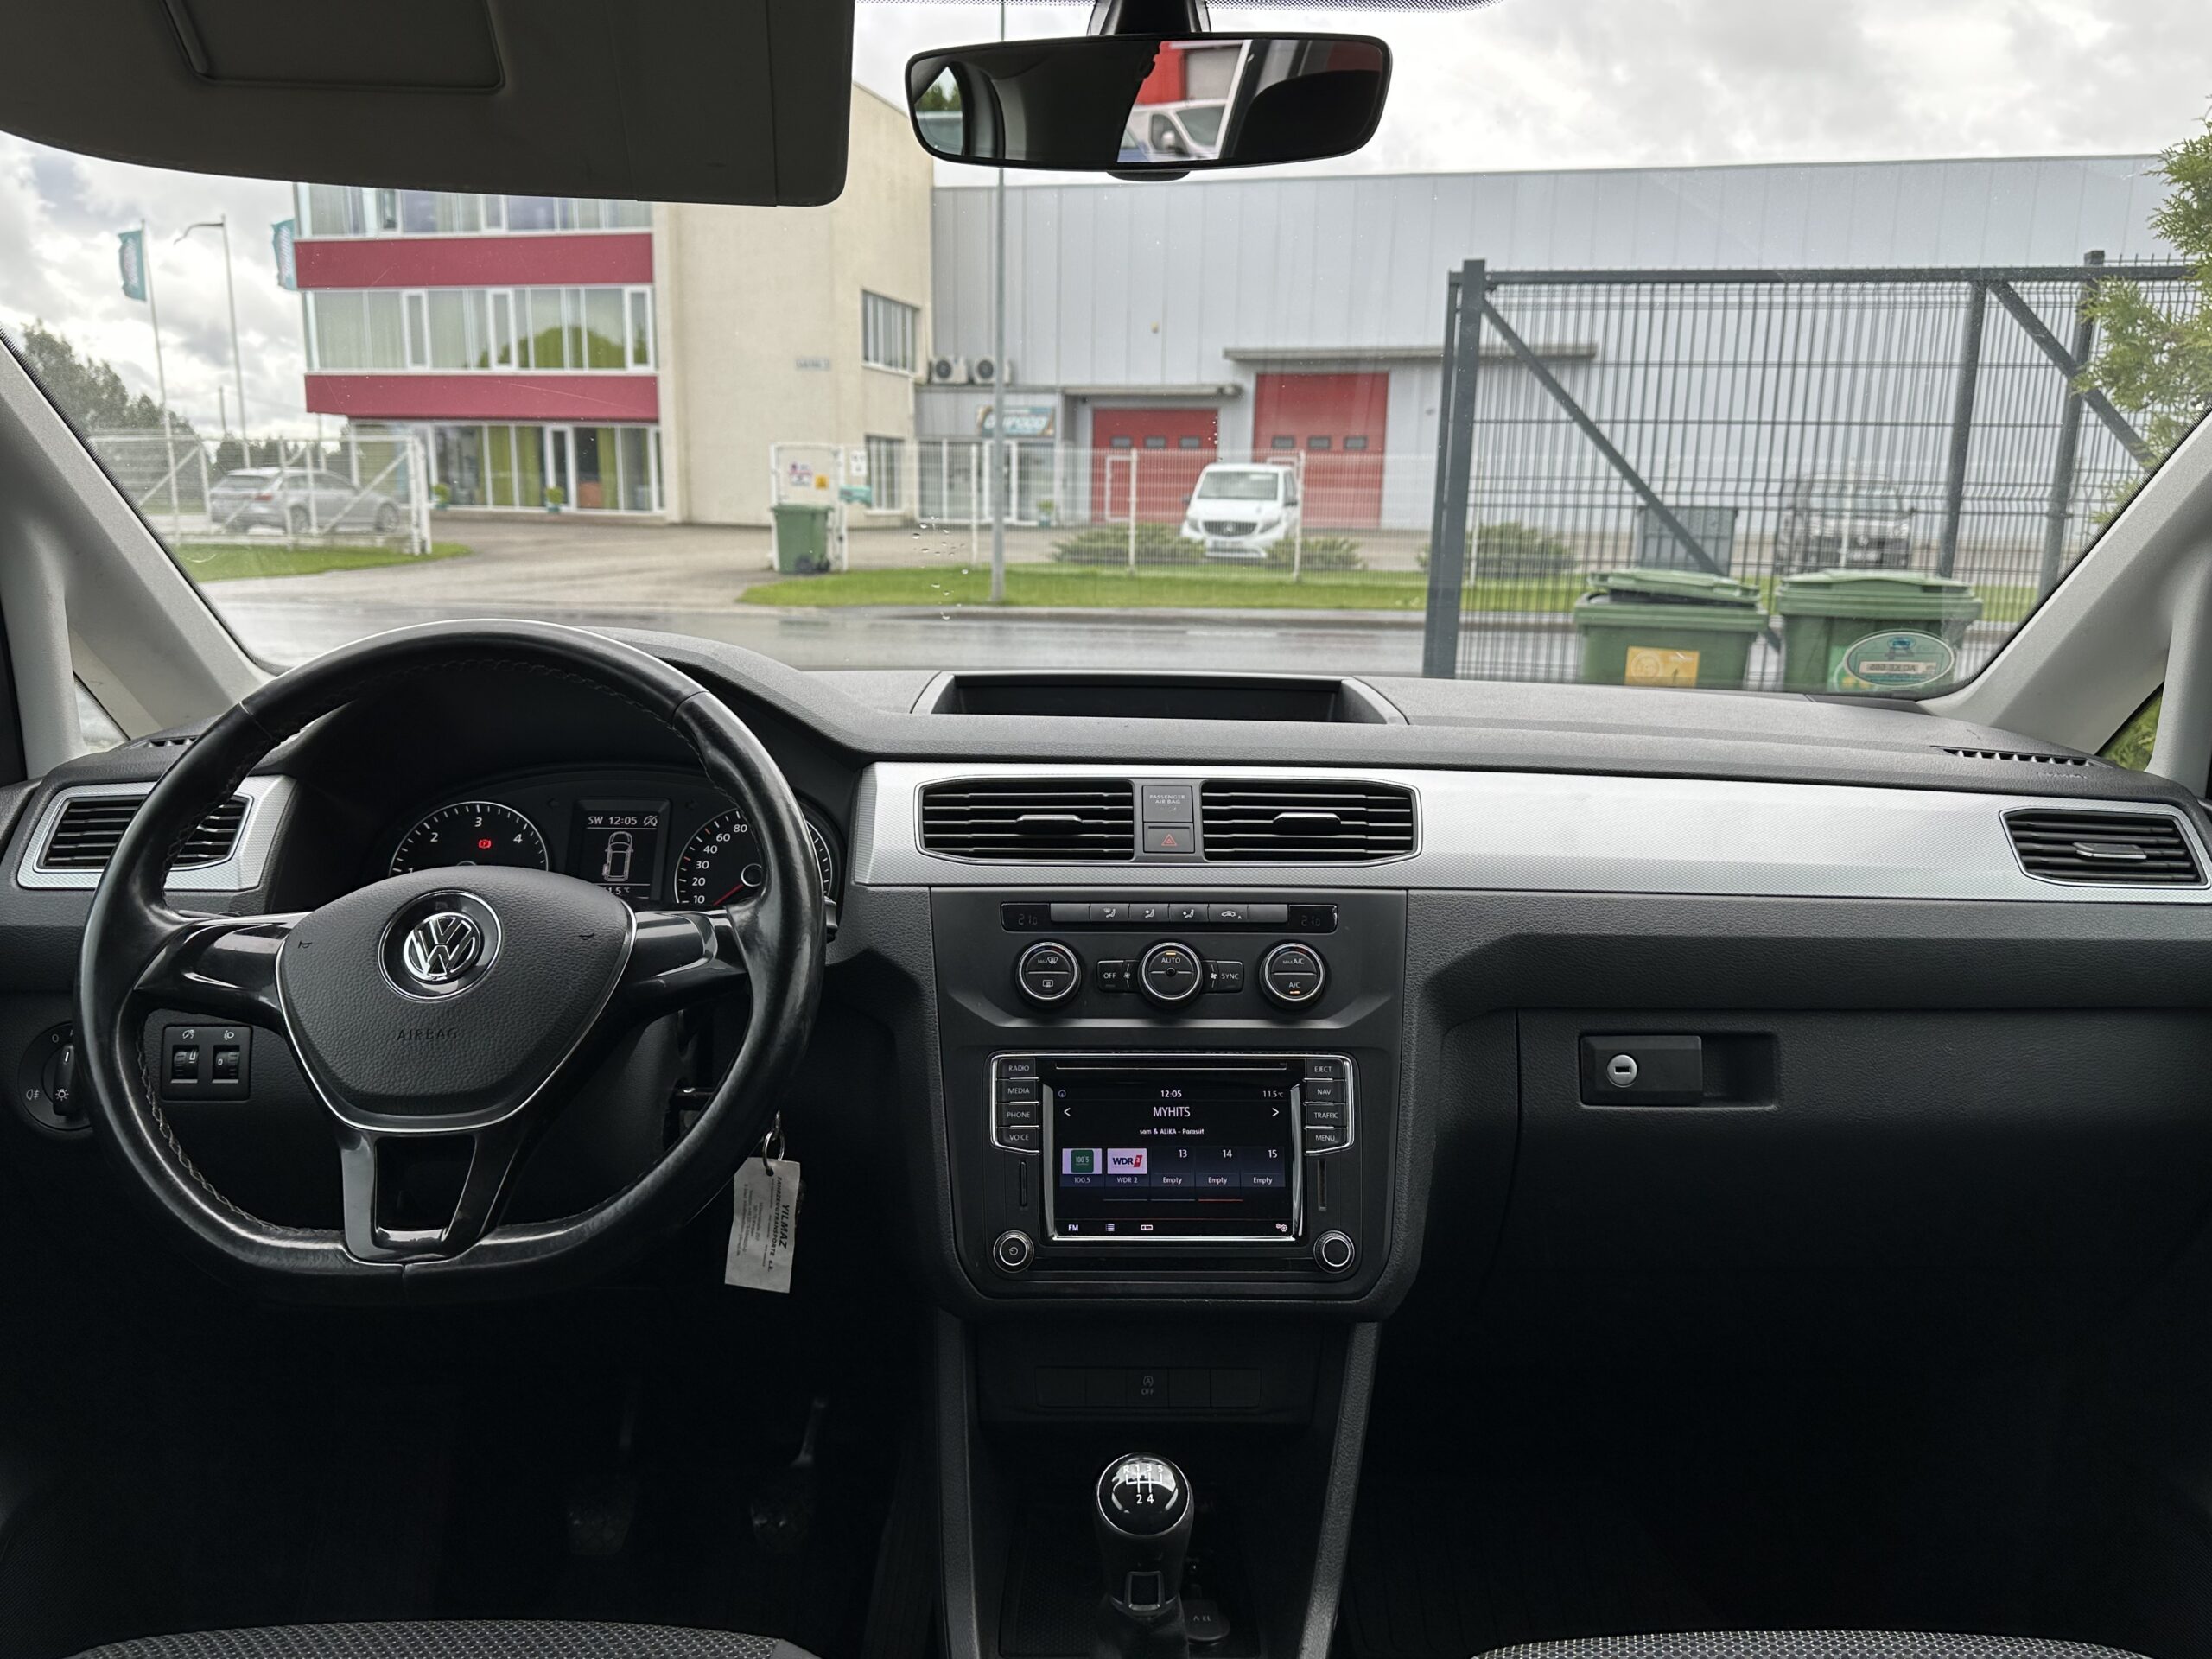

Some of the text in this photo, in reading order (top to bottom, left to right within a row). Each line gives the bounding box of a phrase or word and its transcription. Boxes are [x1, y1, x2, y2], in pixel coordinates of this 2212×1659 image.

[474, 817, 483, 828] 3
[588, 816, 638, 825] SW 12:05
[733, 823, 748, 833] 80
[430, 832, 439, 842] 2
[513, 833, 523, 844] 4
[715, 833, 731, 842] 60
[703, 844, 718, 854] 40
[695, 861, 710, 870] 30
[691, 877, 706, 887] 20
[693, 895, 705, 905] 10
[1103, 971, 1117, 980] OFF
[397, 1027, 458, 1040] AIRBAG
[1160, 1090, 1182, 1098] 12:05
[1153, 1106, 1192, 1117] MYHITS
[1178, 1148, 1188, 1159] 13
[1222, 1148, 1233, 1159] 14
[1268, 1148, 1278, 1159] 15
[1112, 1157, 1134, 1166] WDR
[1162, 1176, 1183, 1185] Empty
[1208, 1176, 1228, 1185] Empty
[1253, 1176, 1273, 1185] Empty
[770, 1176, 782, 1256] FAHRZEUGTRANSPORTE
[779, 1204, 790, 1249] YILMAZ
[1123, 1465, 1130, 1474] R
[1146, 1464, 1152, 1472] 3
[1158, 1465, 1164, 1473] 5
[1135, 1493, 1154, 1504] 2 4
